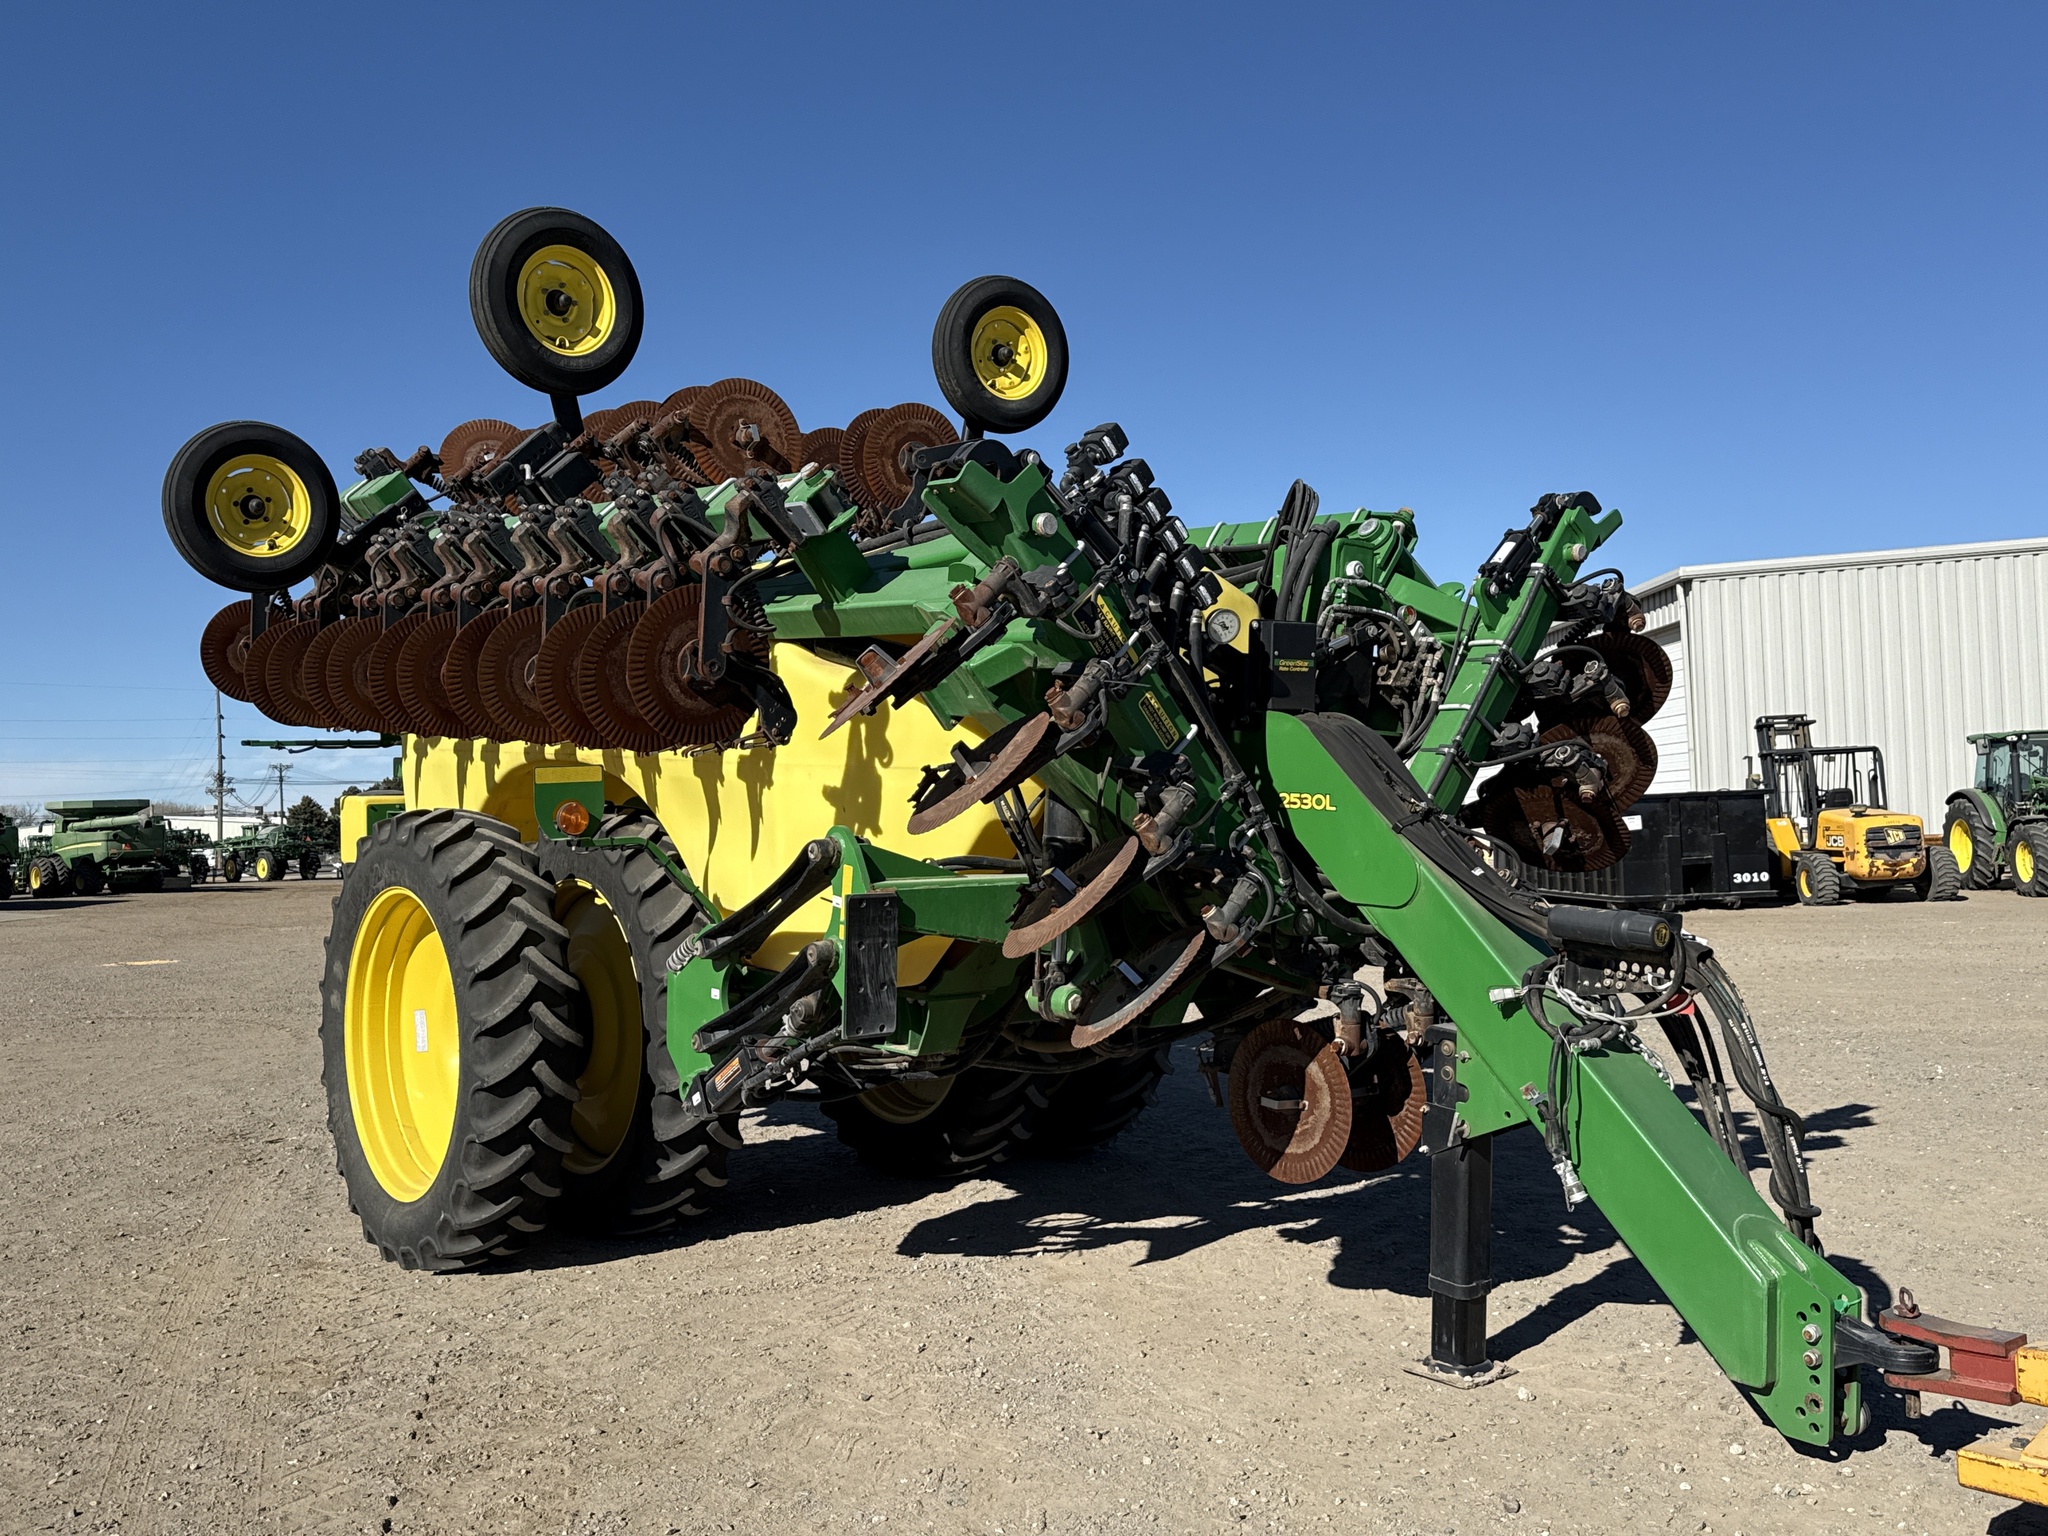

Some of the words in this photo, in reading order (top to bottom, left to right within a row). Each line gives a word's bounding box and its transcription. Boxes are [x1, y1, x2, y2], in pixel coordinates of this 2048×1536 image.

[1104, 612, 1128, 644] CAUTIO
[1279, 659, 1310, 667] GreenStar
[1151, 700, 1178, 737] CAUTION
[1279, 792, 1337, 811] 2530L
[1826, 835, 1845, 847] JCB
[1887, 829, 1905, 844] JCB
[1733, 871, 1770, 884] 3010
